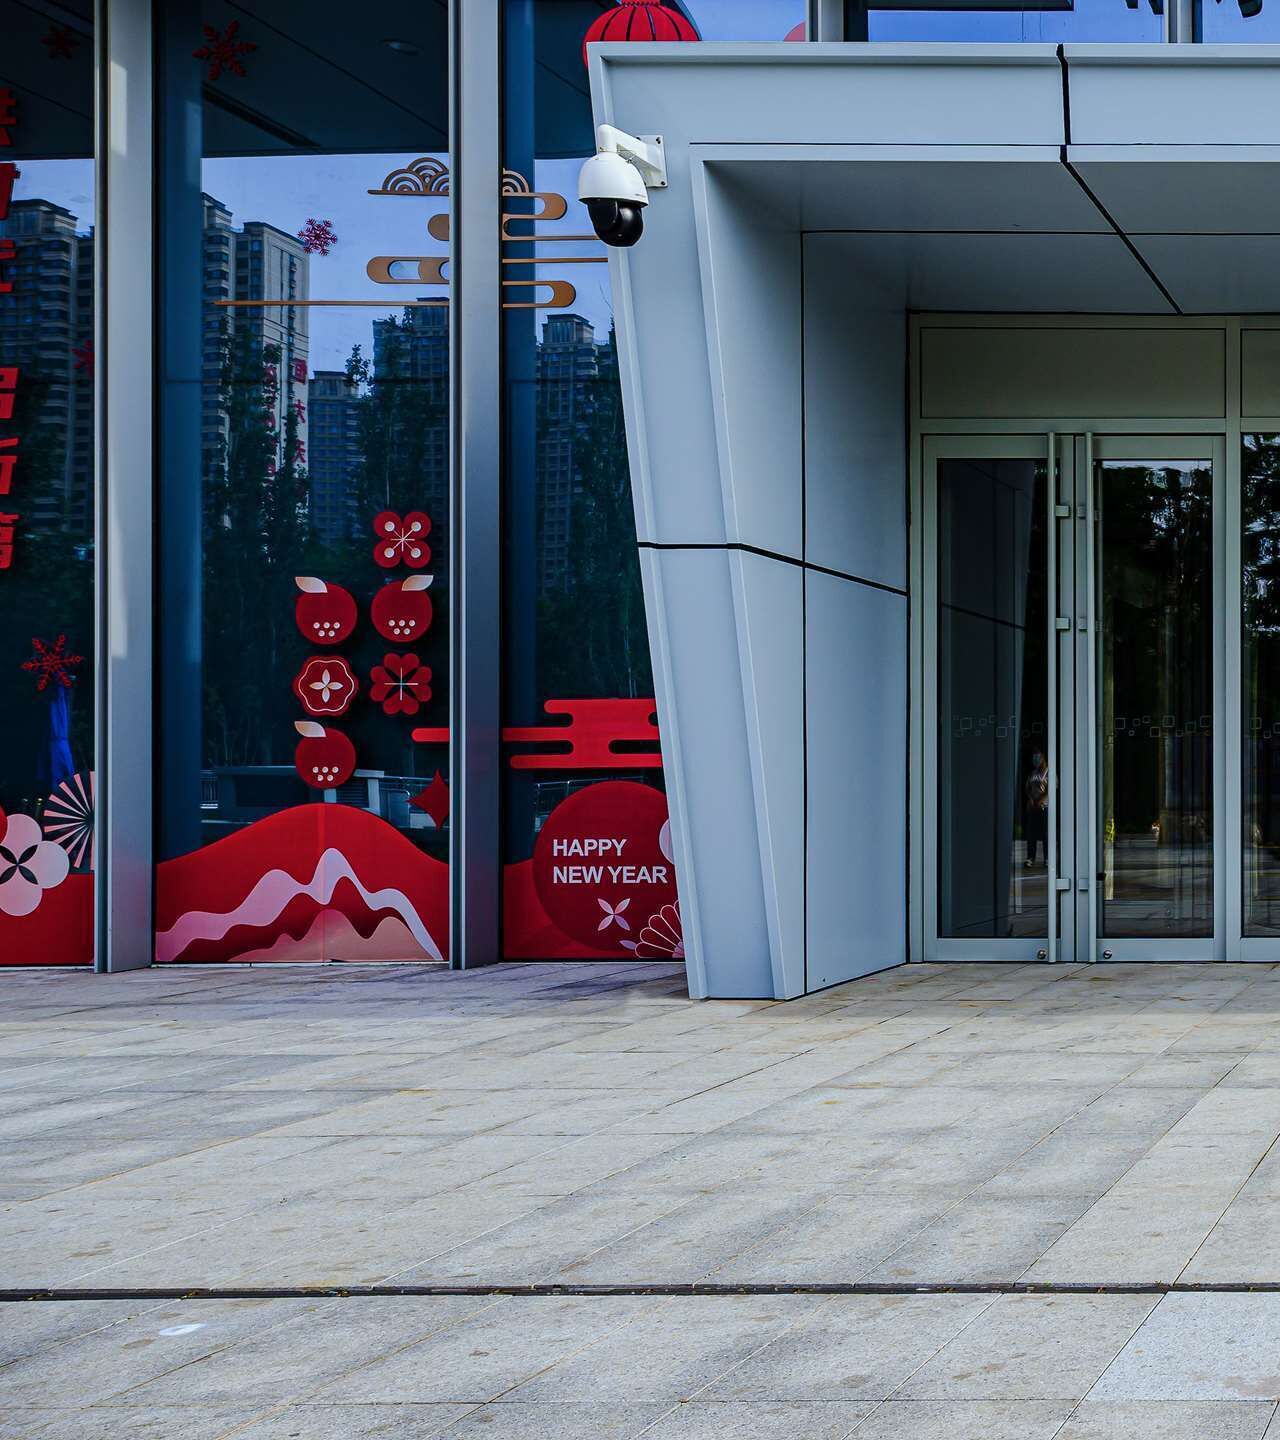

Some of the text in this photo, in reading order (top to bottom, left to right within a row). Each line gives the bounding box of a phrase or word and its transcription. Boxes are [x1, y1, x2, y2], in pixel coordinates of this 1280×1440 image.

[552, 838, 627, 857] HAPPY
[552, 865, 668, 884] NEW YEAR
